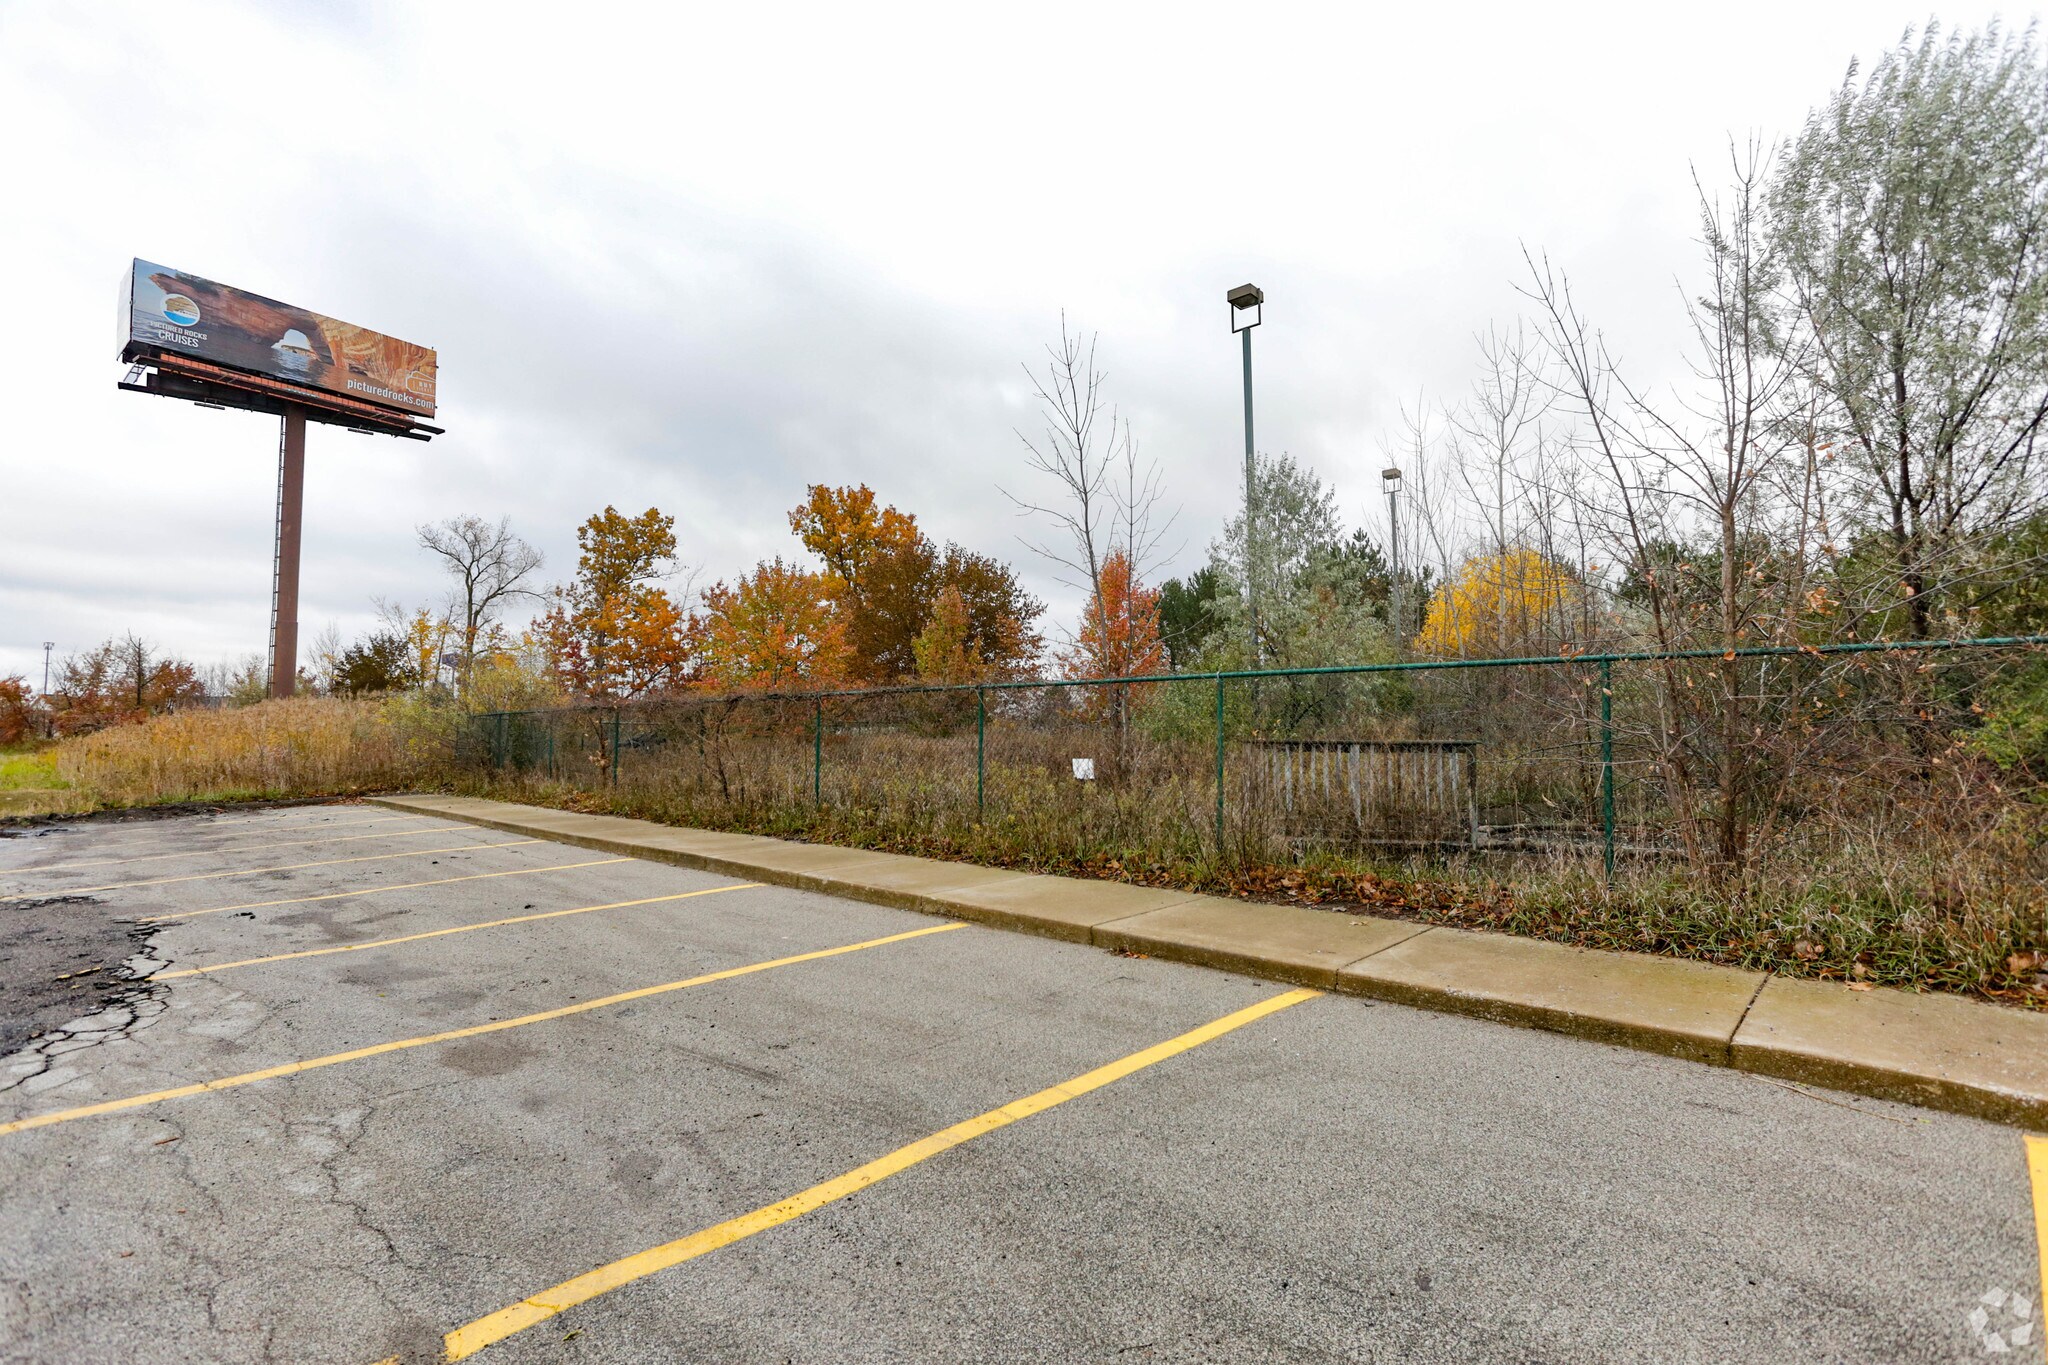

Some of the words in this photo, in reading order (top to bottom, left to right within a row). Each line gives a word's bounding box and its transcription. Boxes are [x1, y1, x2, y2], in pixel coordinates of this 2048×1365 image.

[151, 321, 183, 334] PICTURED
[184, 329, 208, 341] ROCKS
[158, 330, 199, 348] CRUISES
[347, 379, 434, 410] picturedrocks.com
